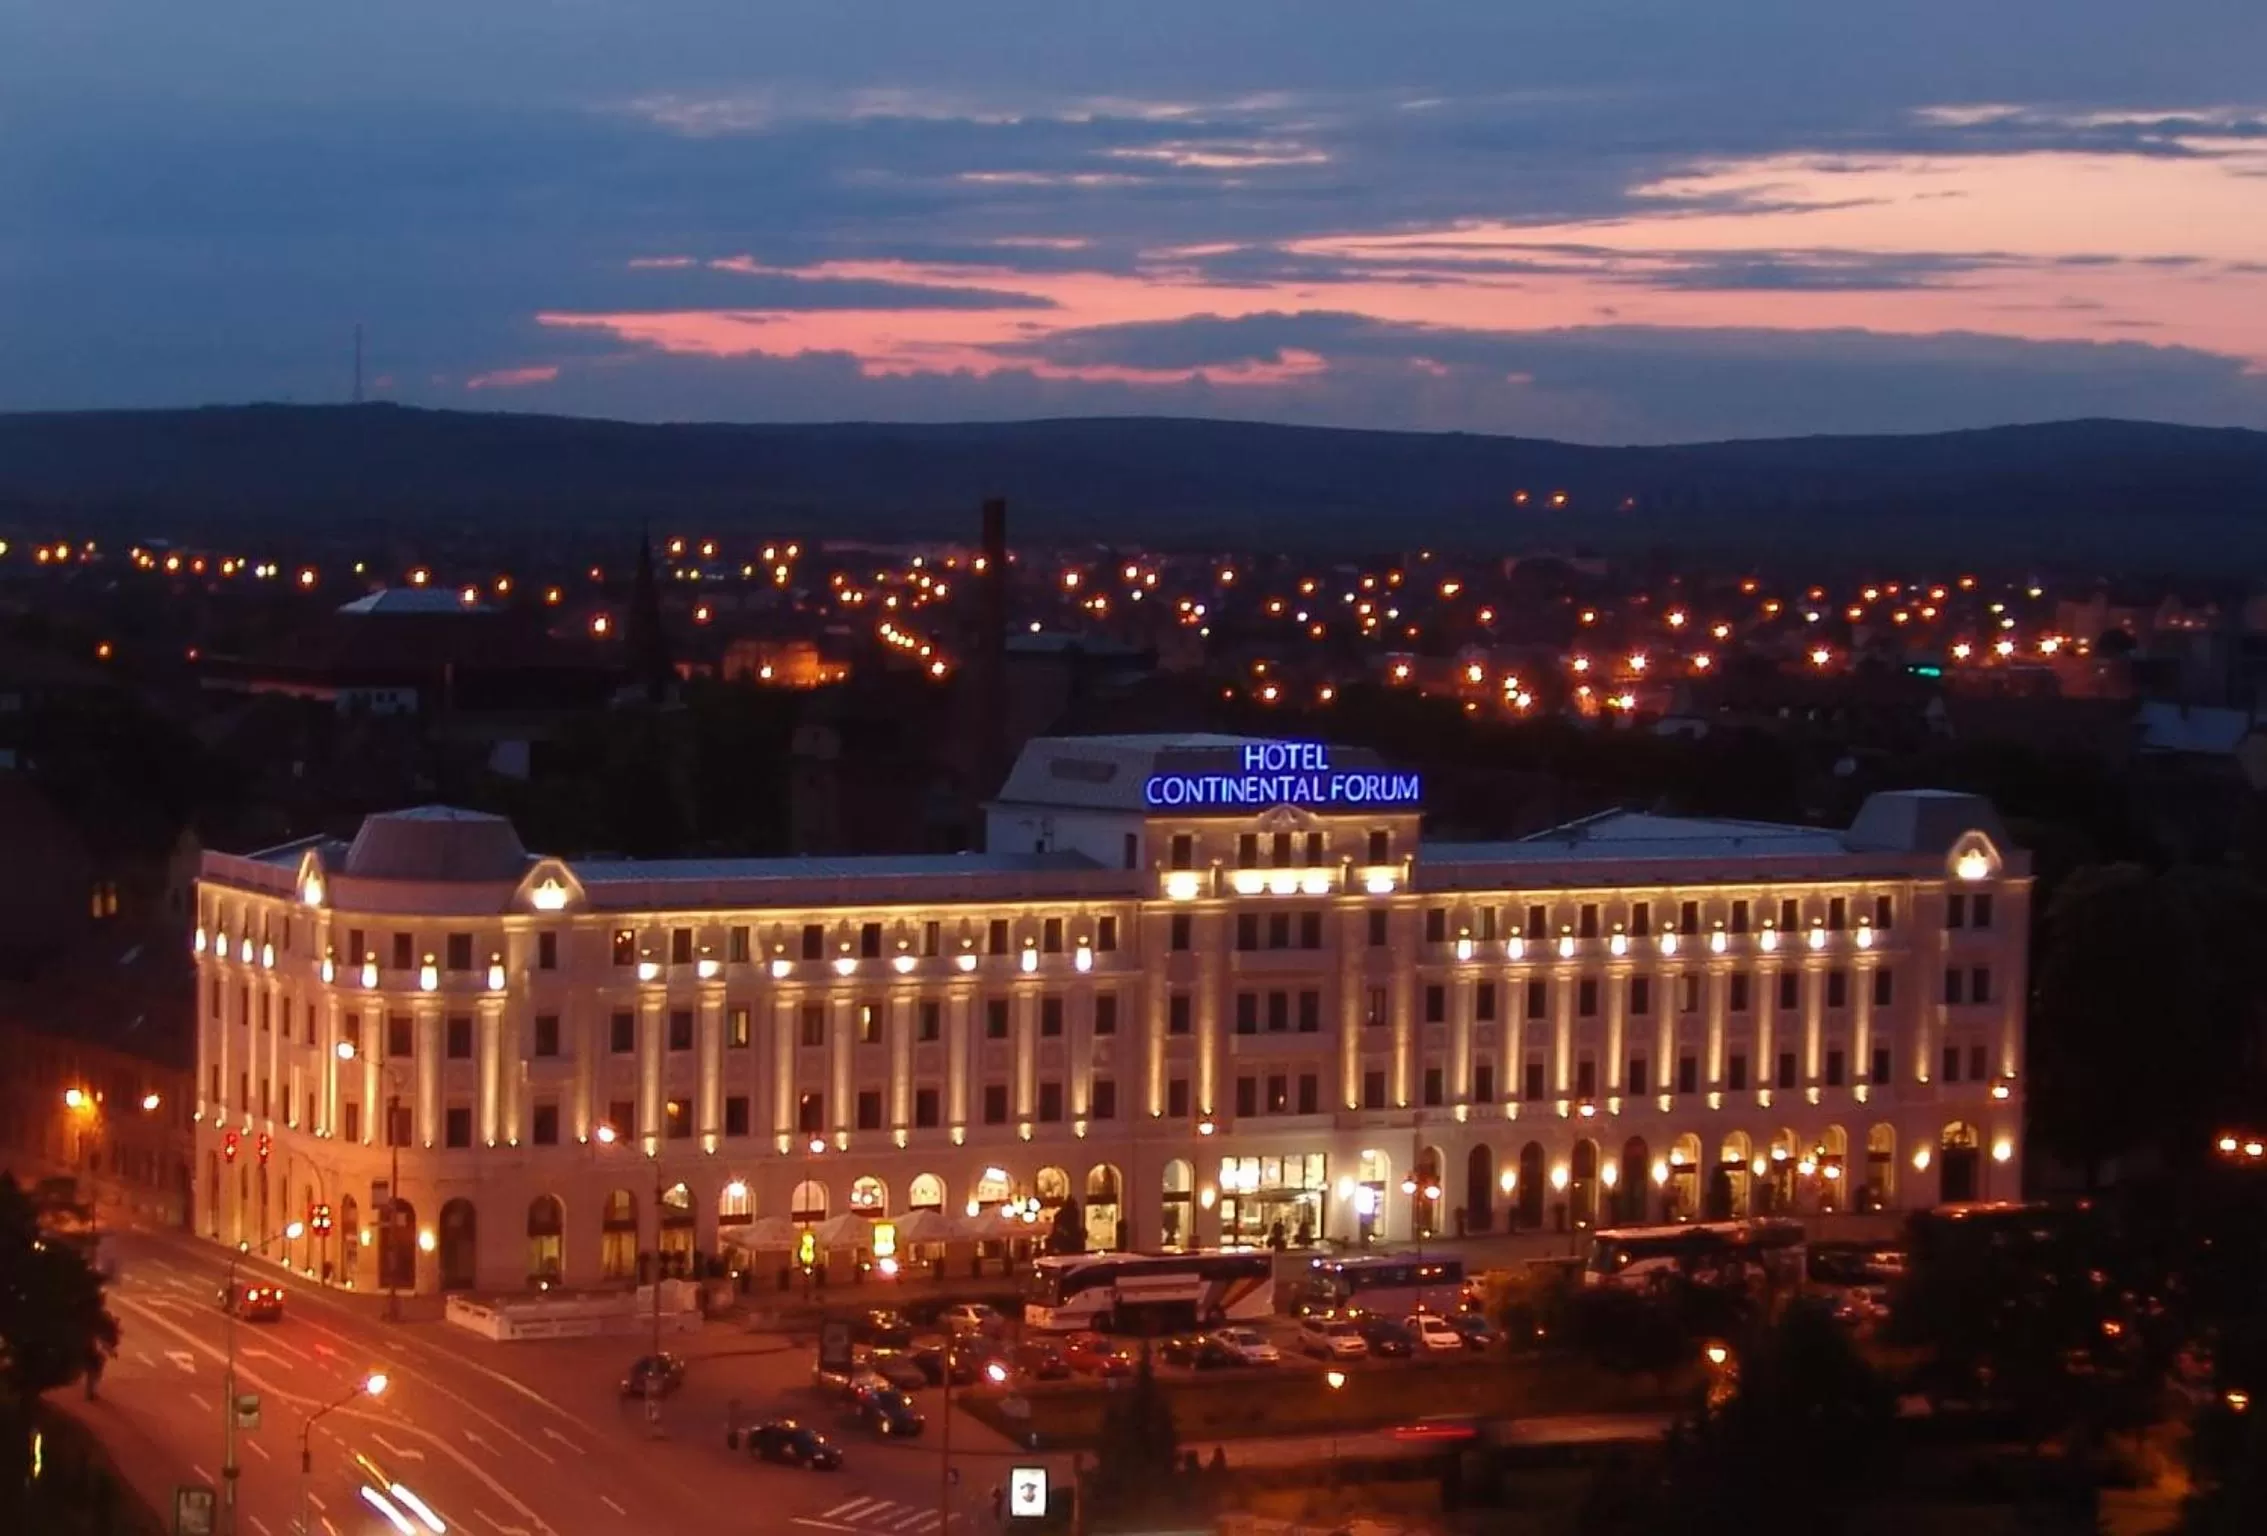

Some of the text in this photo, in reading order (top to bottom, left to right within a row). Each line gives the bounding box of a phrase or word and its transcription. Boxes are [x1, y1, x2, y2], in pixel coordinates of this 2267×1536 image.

[1244, 743, 1329, 770] HOTEL
[1146, 774, 1419, 804] CONTINENTAL FORUM
